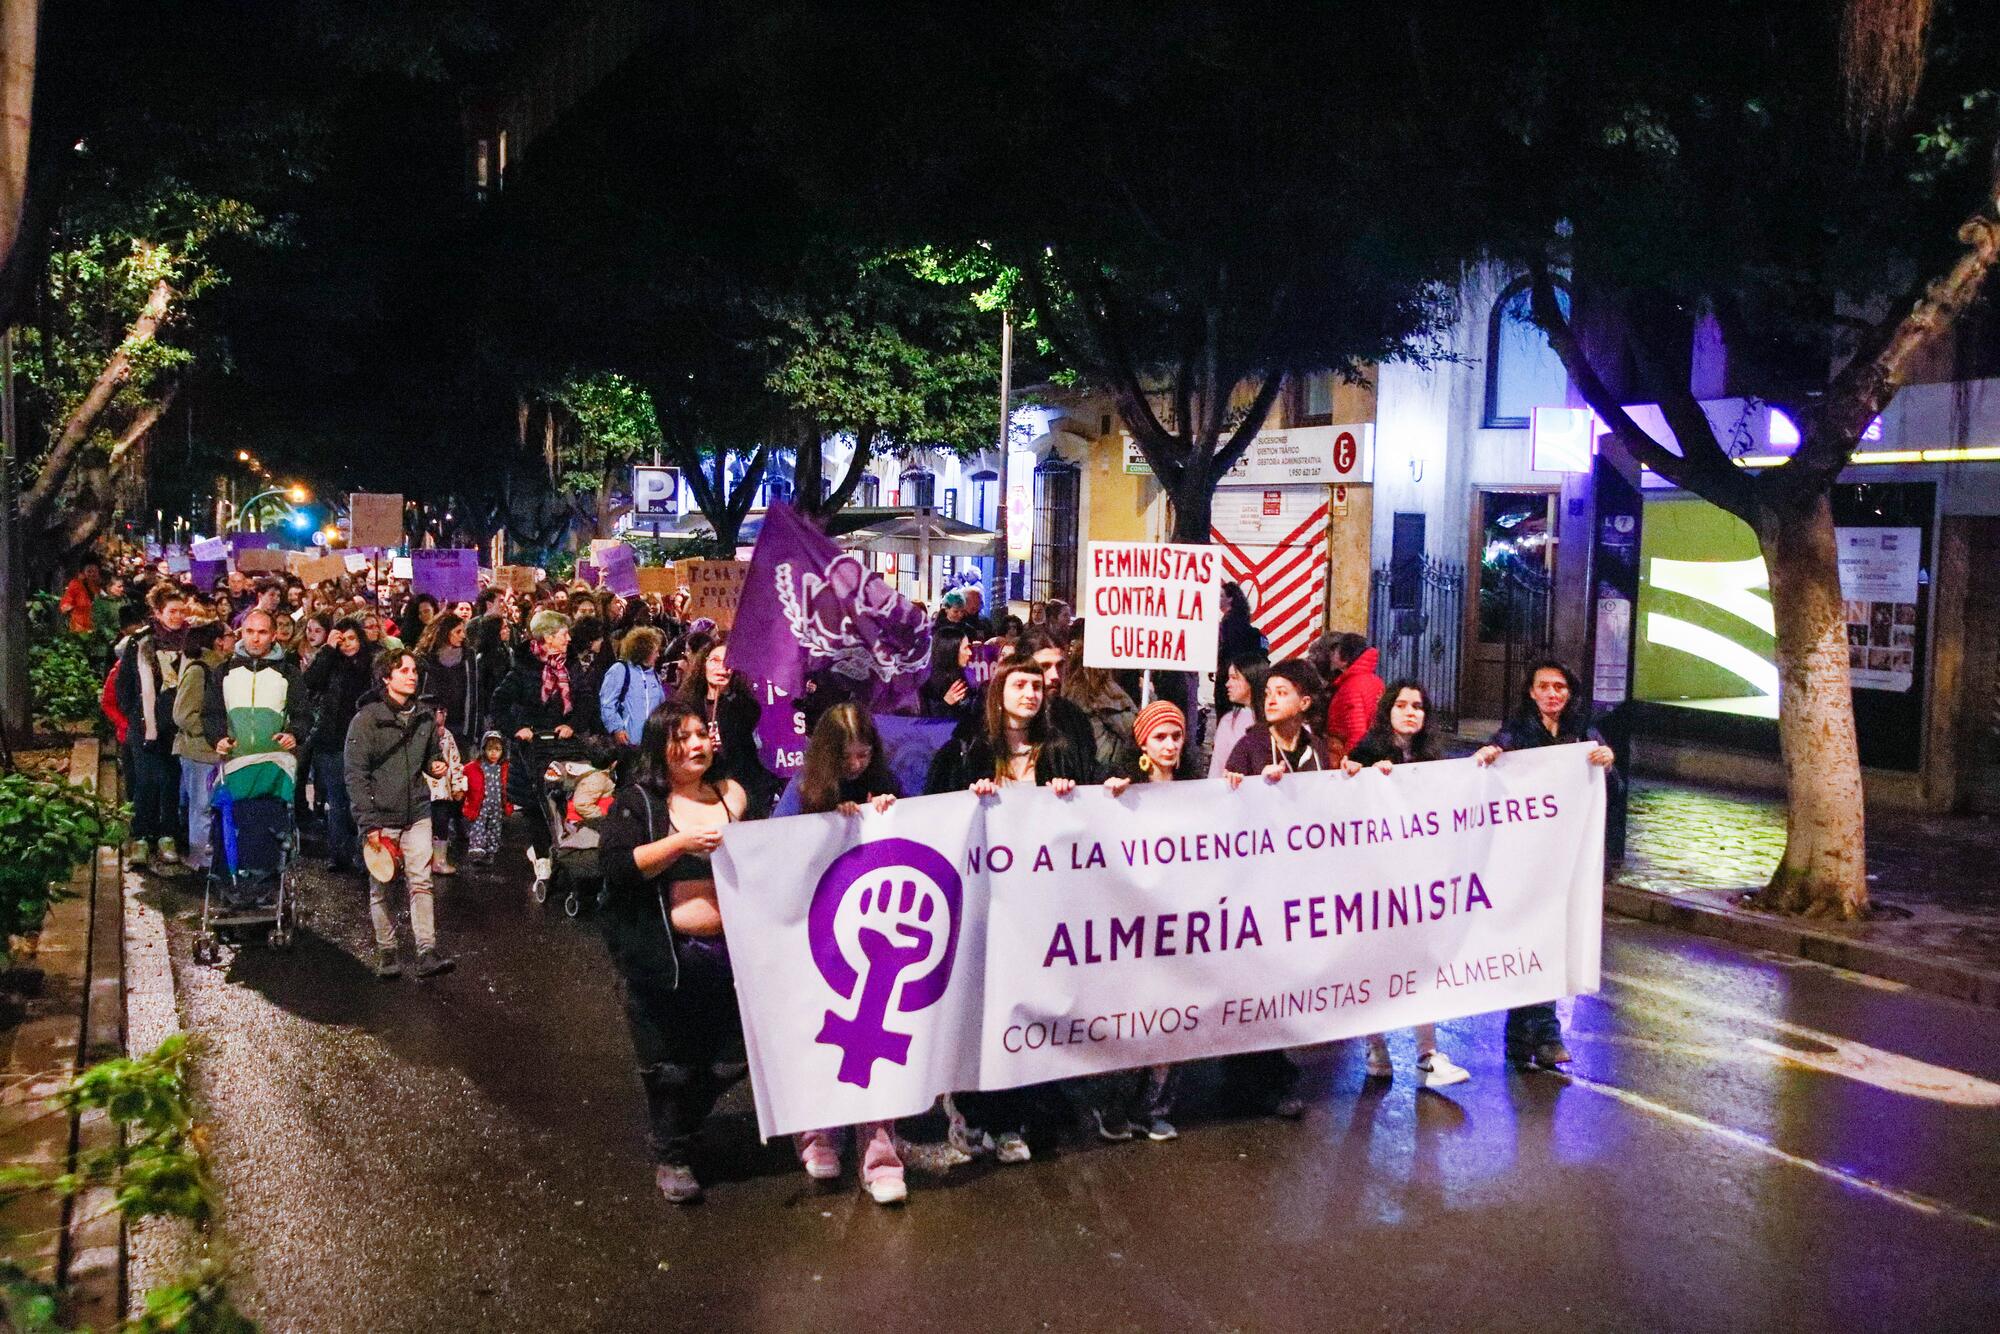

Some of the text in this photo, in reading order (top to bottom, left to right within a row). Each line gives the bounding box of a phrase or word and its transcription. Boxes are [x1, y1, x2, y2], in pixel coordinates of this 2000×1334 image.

[638, 470, 675, 512] P
[1094, 547, 1214, 585] FEMINISTAS
[1095, 585, 1203, 621] CONTRA LA
[1111, 625, 1186, 661] GUERRA
[775, 747, 805, 768] Asa
[967, 794, 1559, 875] NO A LA VIOLENCIA CONTRA LAS MUJERES
[1042, 872, 1493, 968] ALMERÍA FEMINISTA
[1003, 946, 1544, 1053] COLECTIVOS FEMINISTAS DE ALMERÍA
